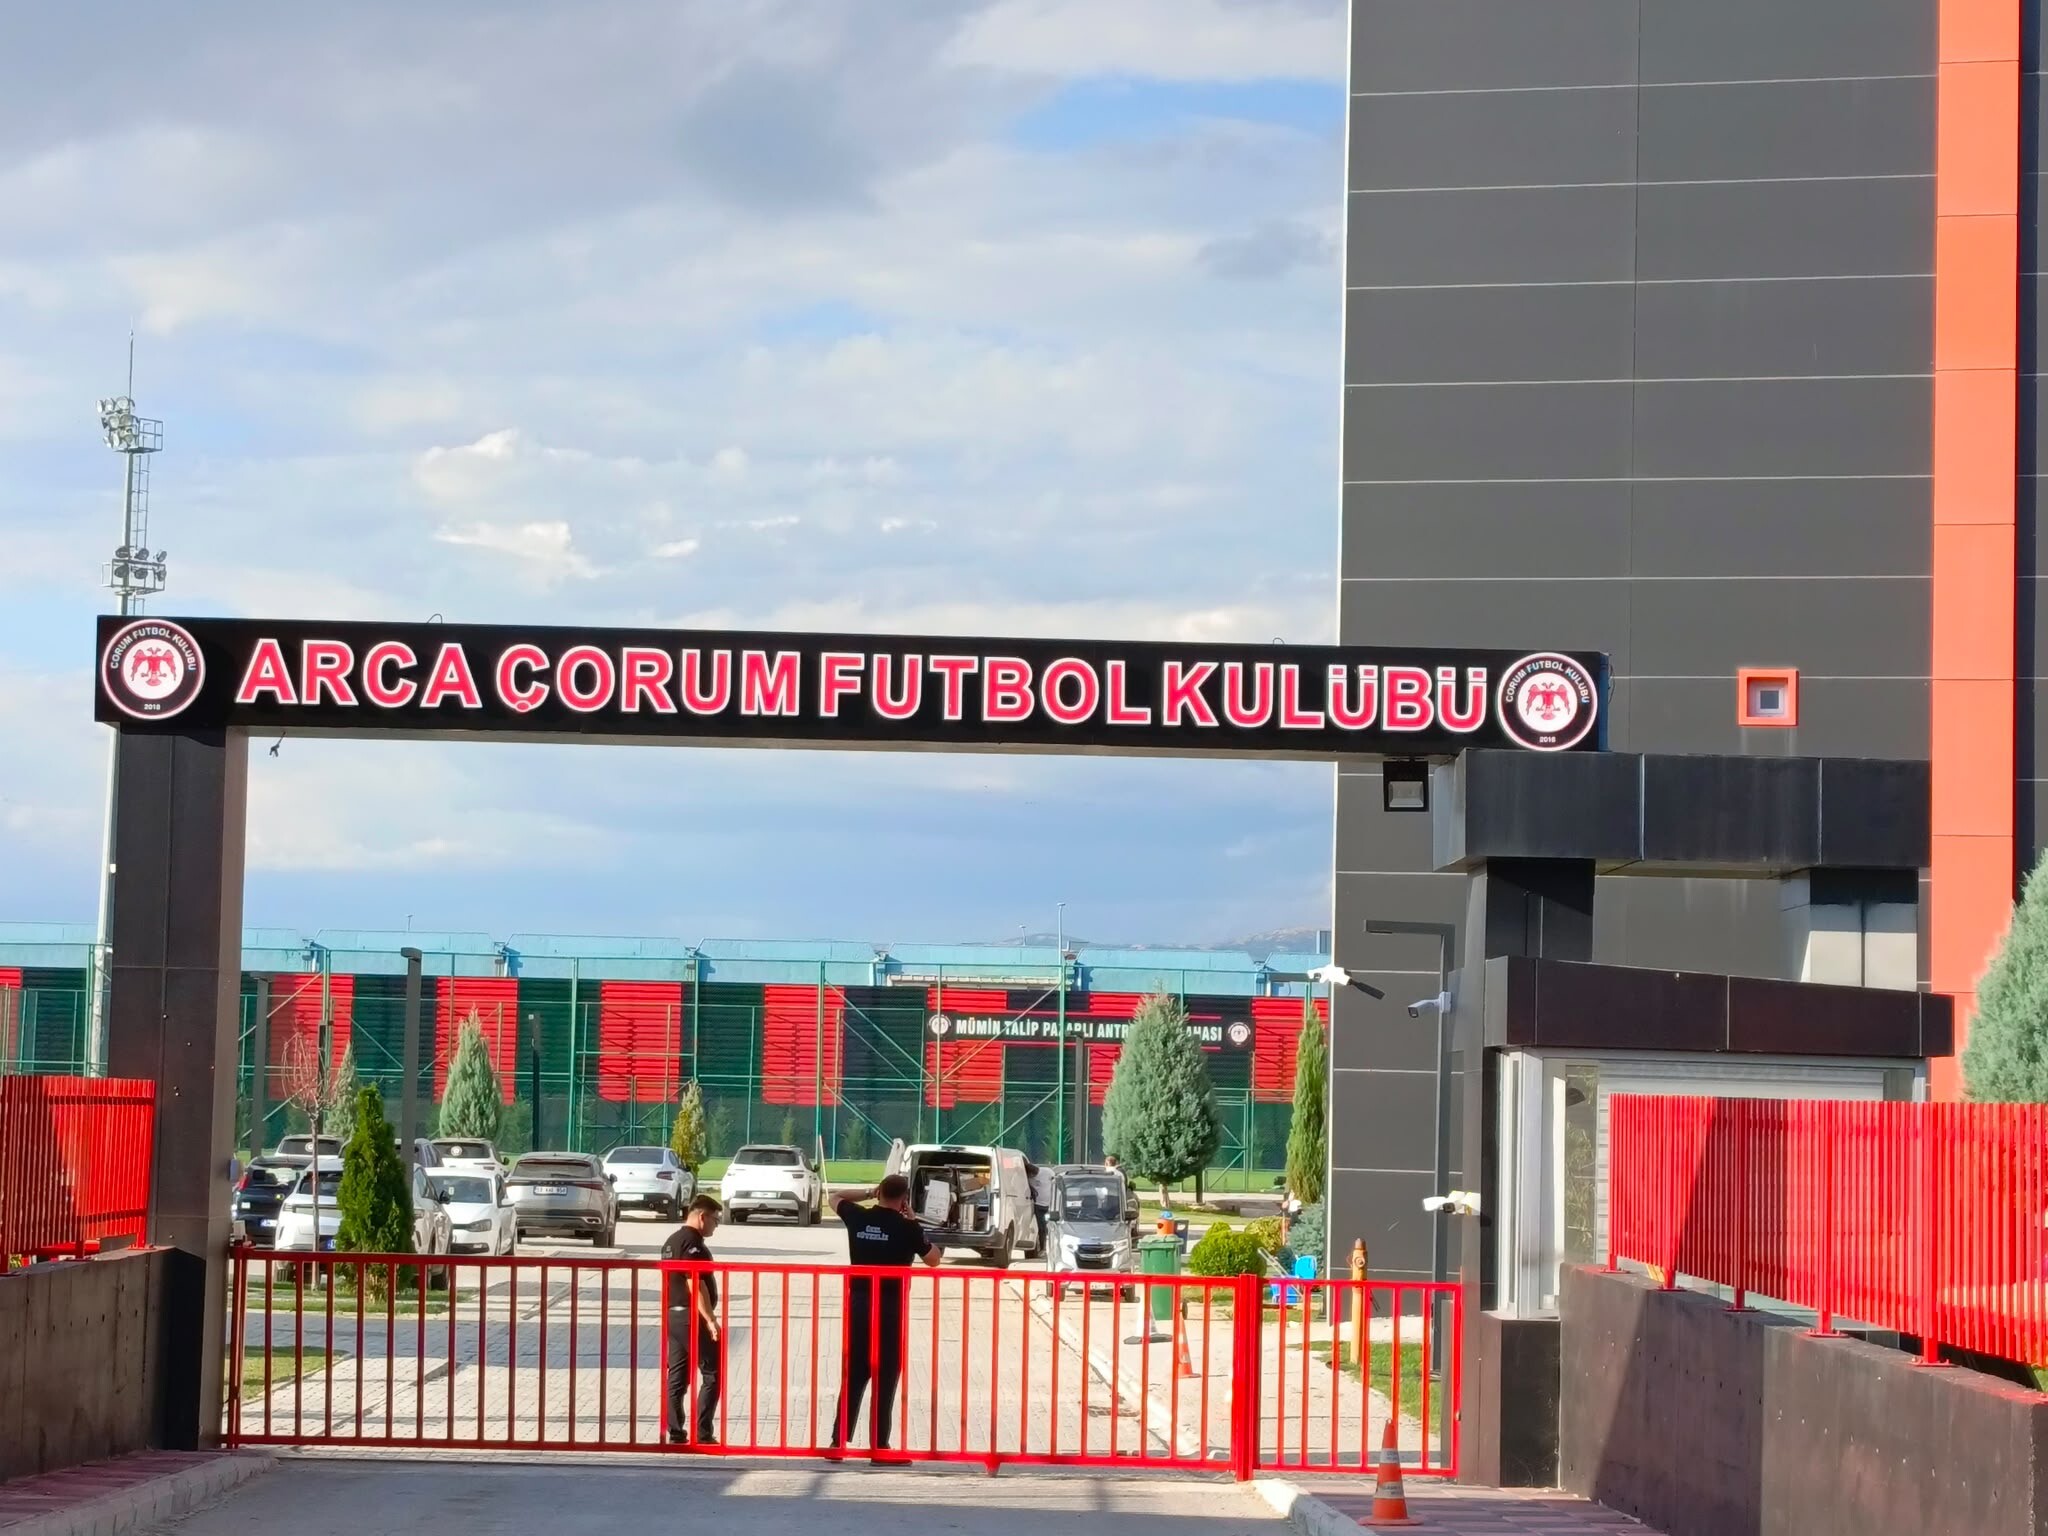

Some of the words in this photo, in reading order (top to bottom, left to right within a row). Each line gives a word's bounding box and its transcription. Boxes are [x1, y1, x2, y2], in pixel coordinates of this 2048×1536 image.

[133, 627, 171, 639] FUTBOL
[1527, 660, 1564, 672] FUTBOL
[235, 638, 483, 708] ARCA
[496, 643, 801, 716] ÇORUM
[819, 652, 1152, 725] FUTBOL
[1162, 660, 1488, 733] KULÜBÜ
[956, 1017, 1000, 1035] MÜMİN
[1004, 1019, 1040, 1036] TALİP
